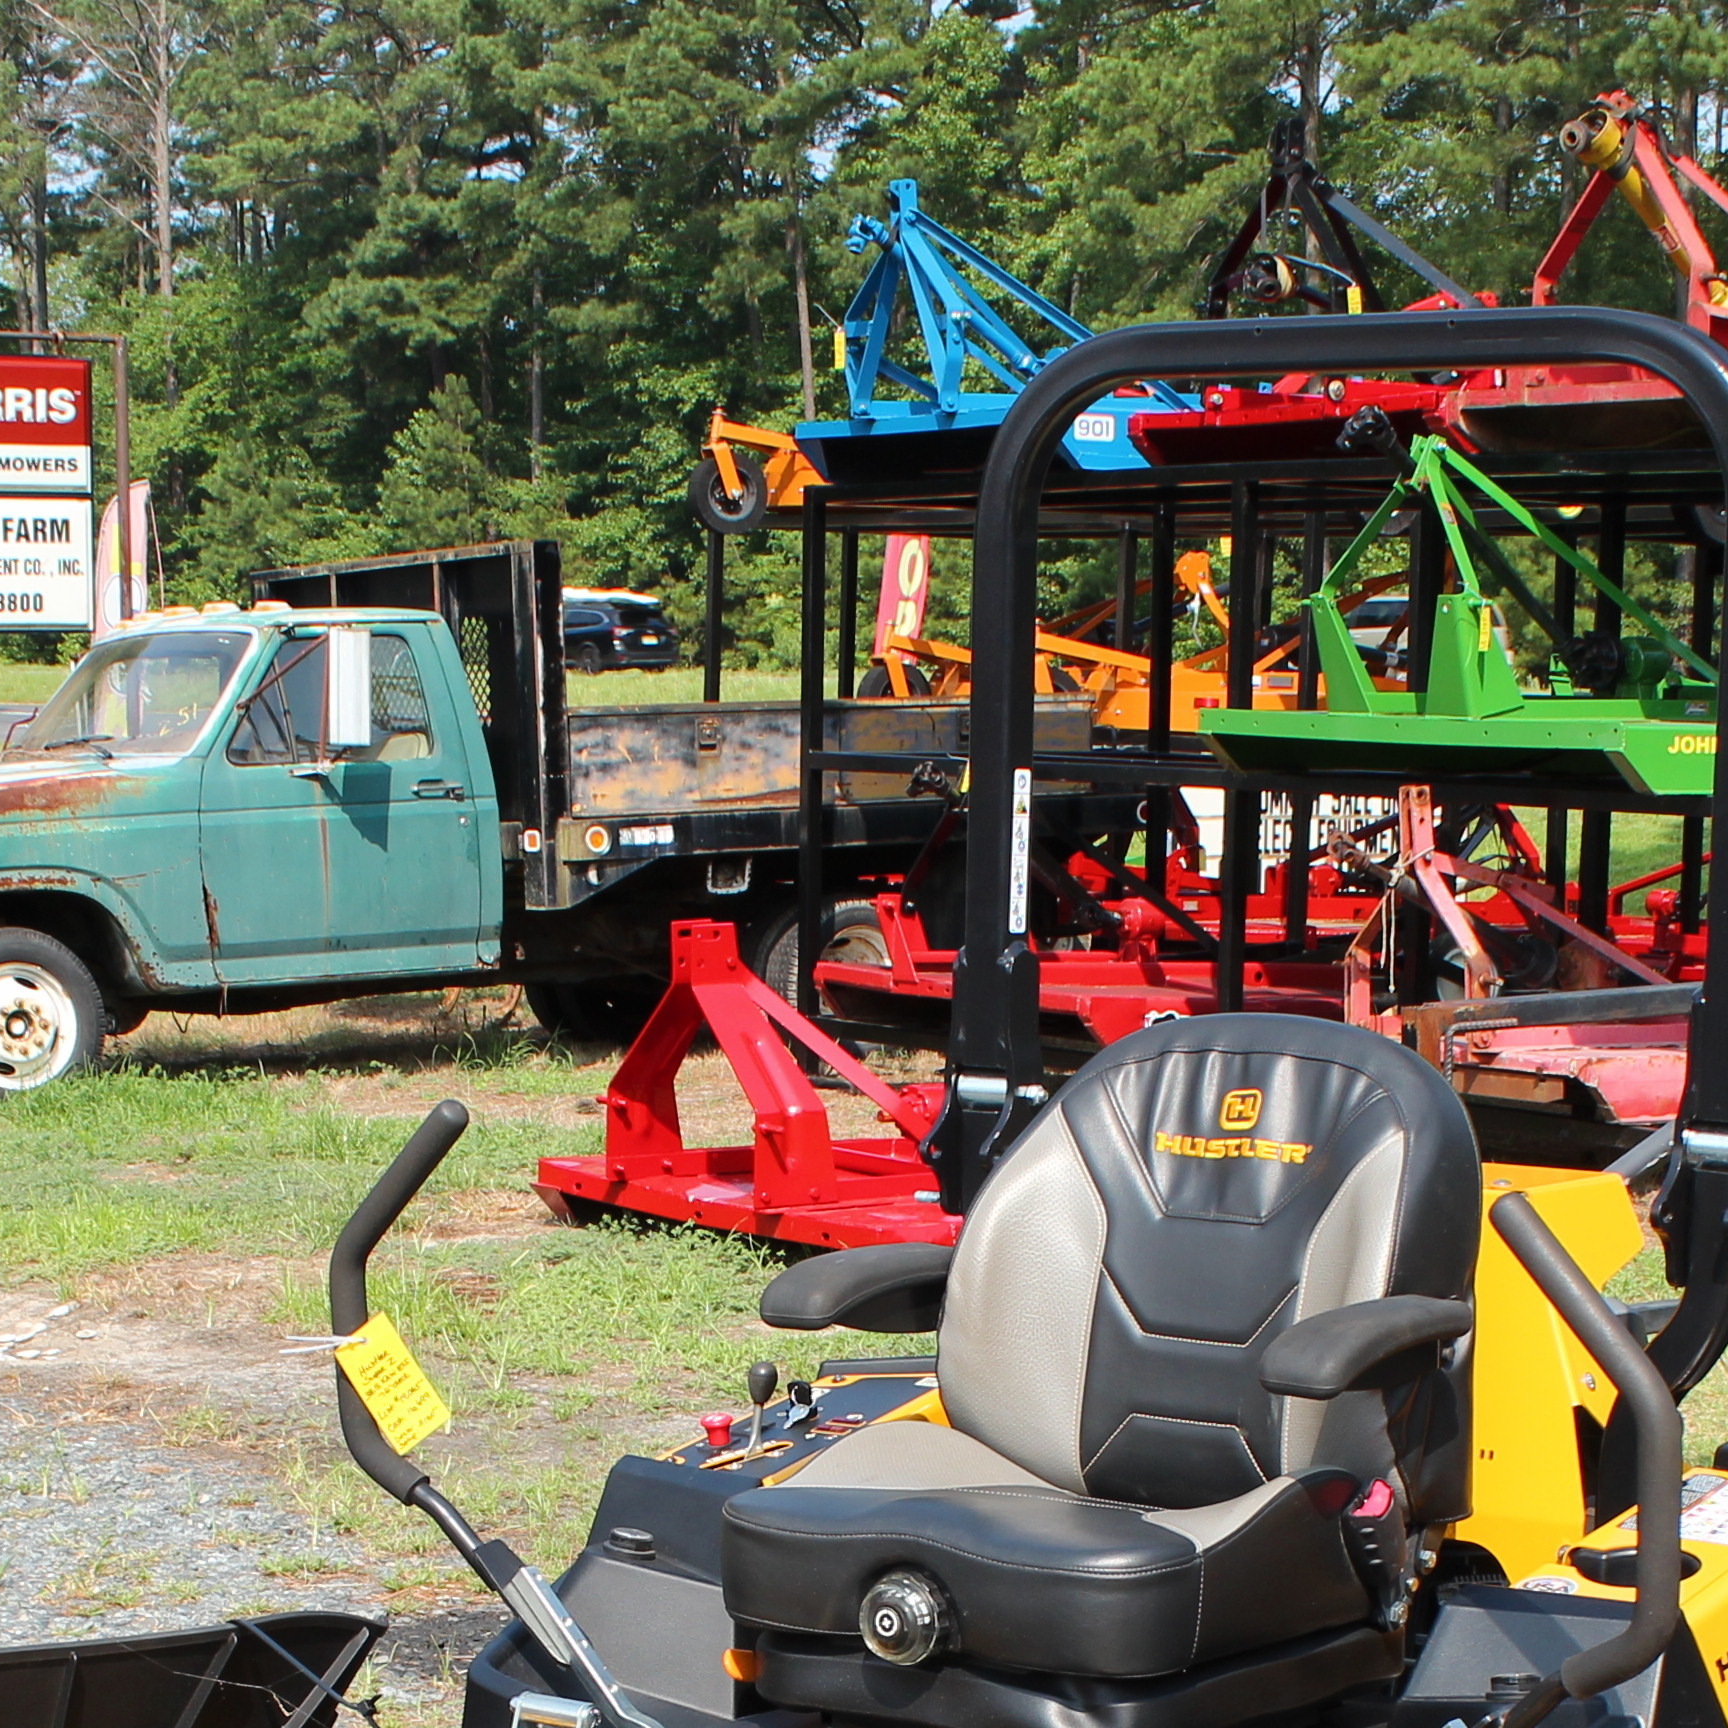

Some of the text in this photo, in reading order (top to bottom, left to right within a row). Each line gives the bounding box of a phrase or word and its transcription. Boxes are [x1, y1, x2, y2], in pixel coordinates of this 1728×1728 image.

[1077, 419, 1113, 437] 901
[2, 518, 71, 544] FARM
[58, 559, 84, 577] INC.
[894, 538, 925, 637] OP
[1155, 1130, 1309, 1165] HUSTLER
